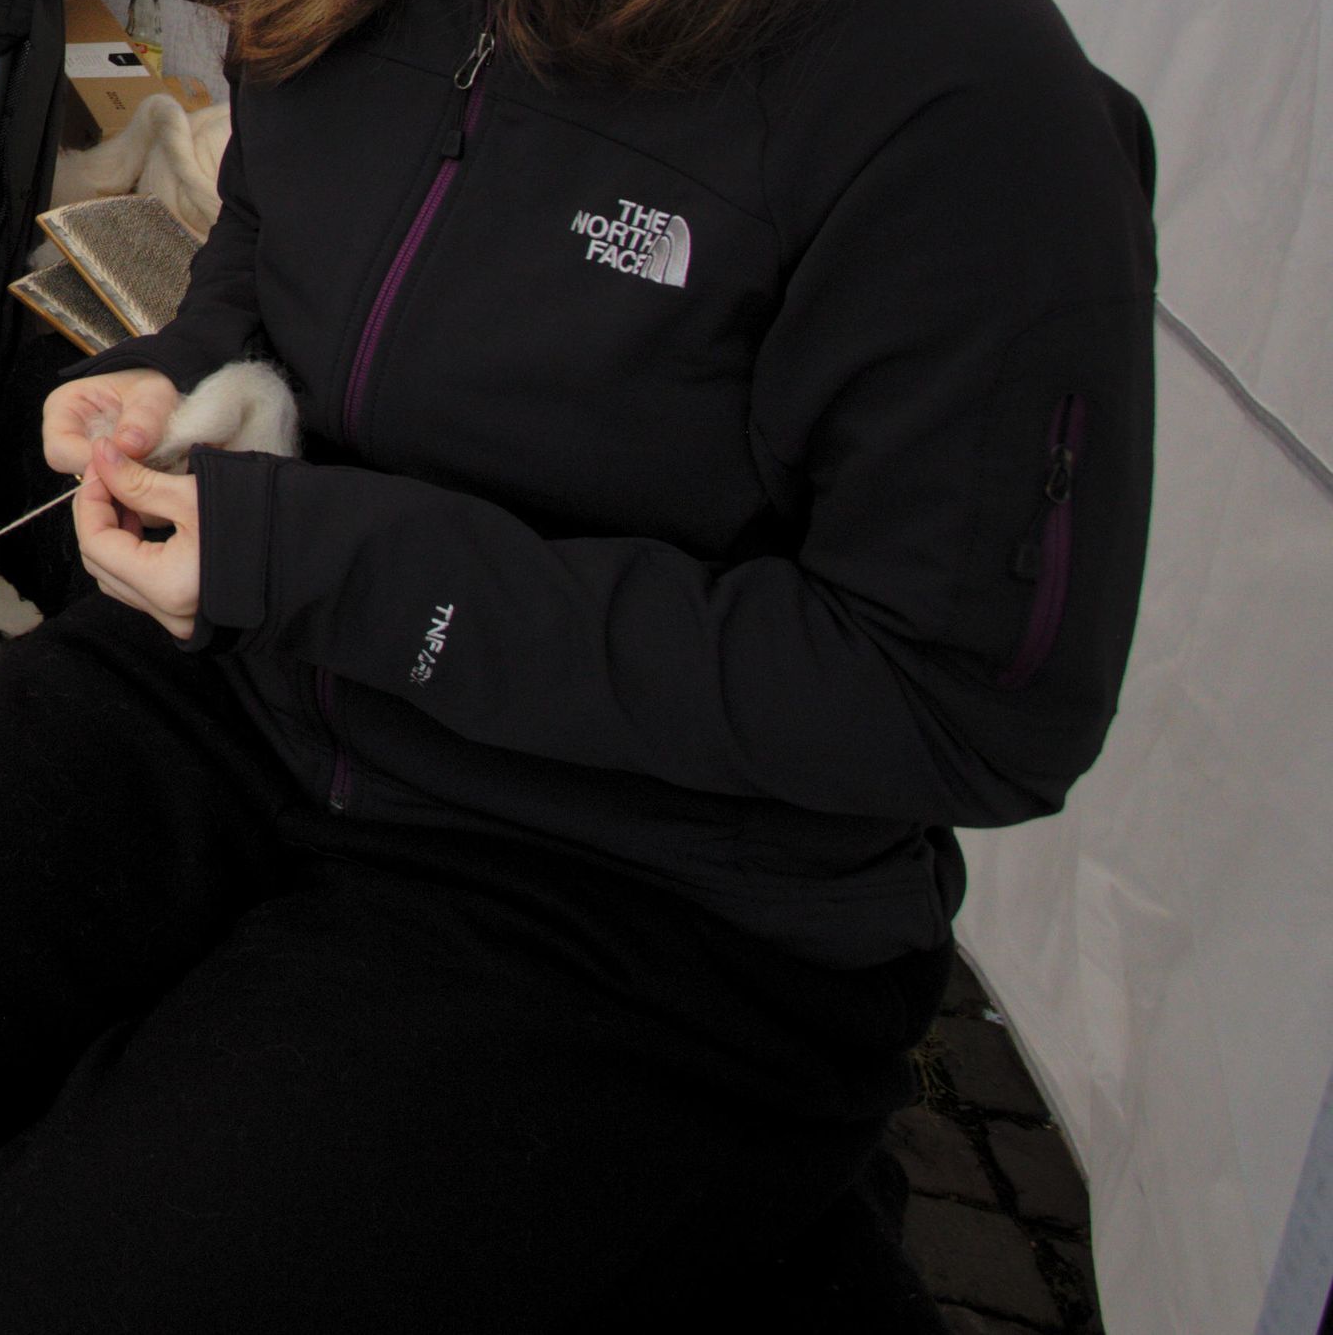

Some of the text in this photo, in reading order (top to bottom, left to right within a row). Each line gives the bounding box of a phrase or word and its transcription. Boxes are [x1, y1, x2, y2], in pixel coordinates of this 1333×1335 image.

[571, 210, 658, 254] NORTH
[618, 199, 670, 234] THE
[586, 238, 649, 275] FACE
